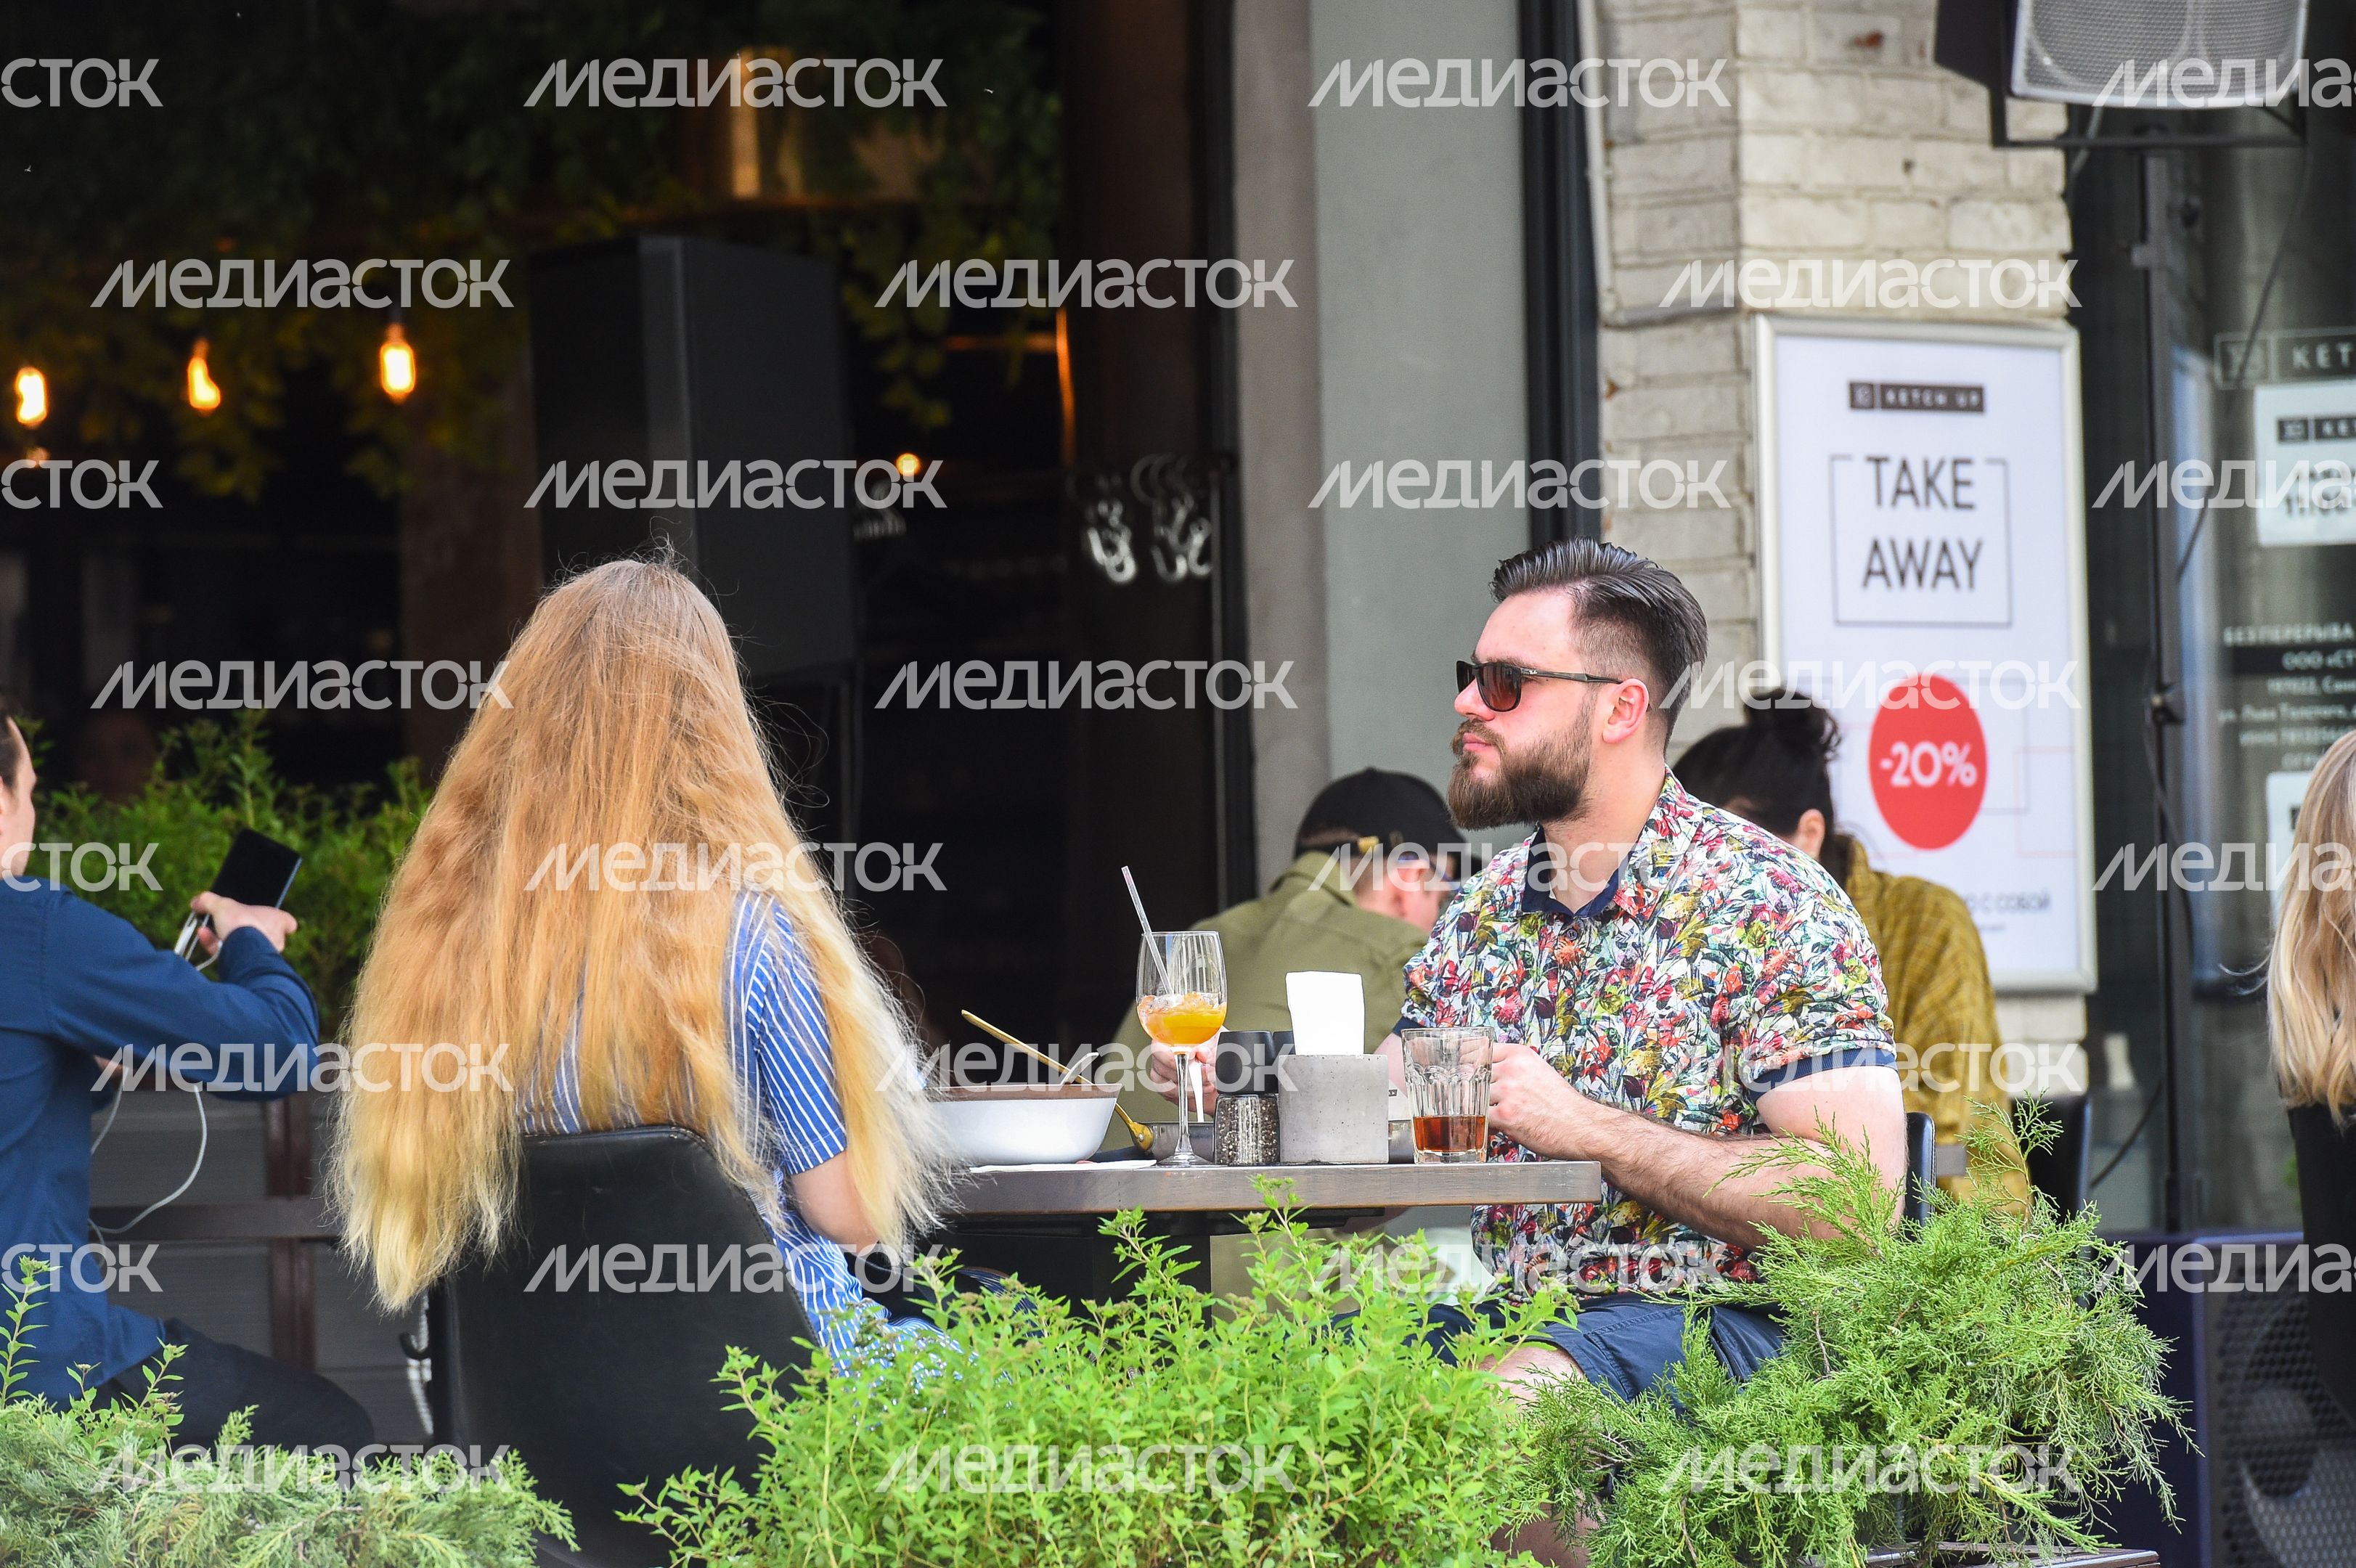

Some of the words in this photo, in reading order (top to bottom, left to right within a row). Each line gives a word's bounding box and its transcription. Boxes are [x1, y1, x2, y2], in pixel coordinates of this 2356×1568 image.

[1865, 455, 1976, 510] TAKE
[1862, 538, 1984, 591] AWAY
[1879, 740, 1978, 788] -20%
